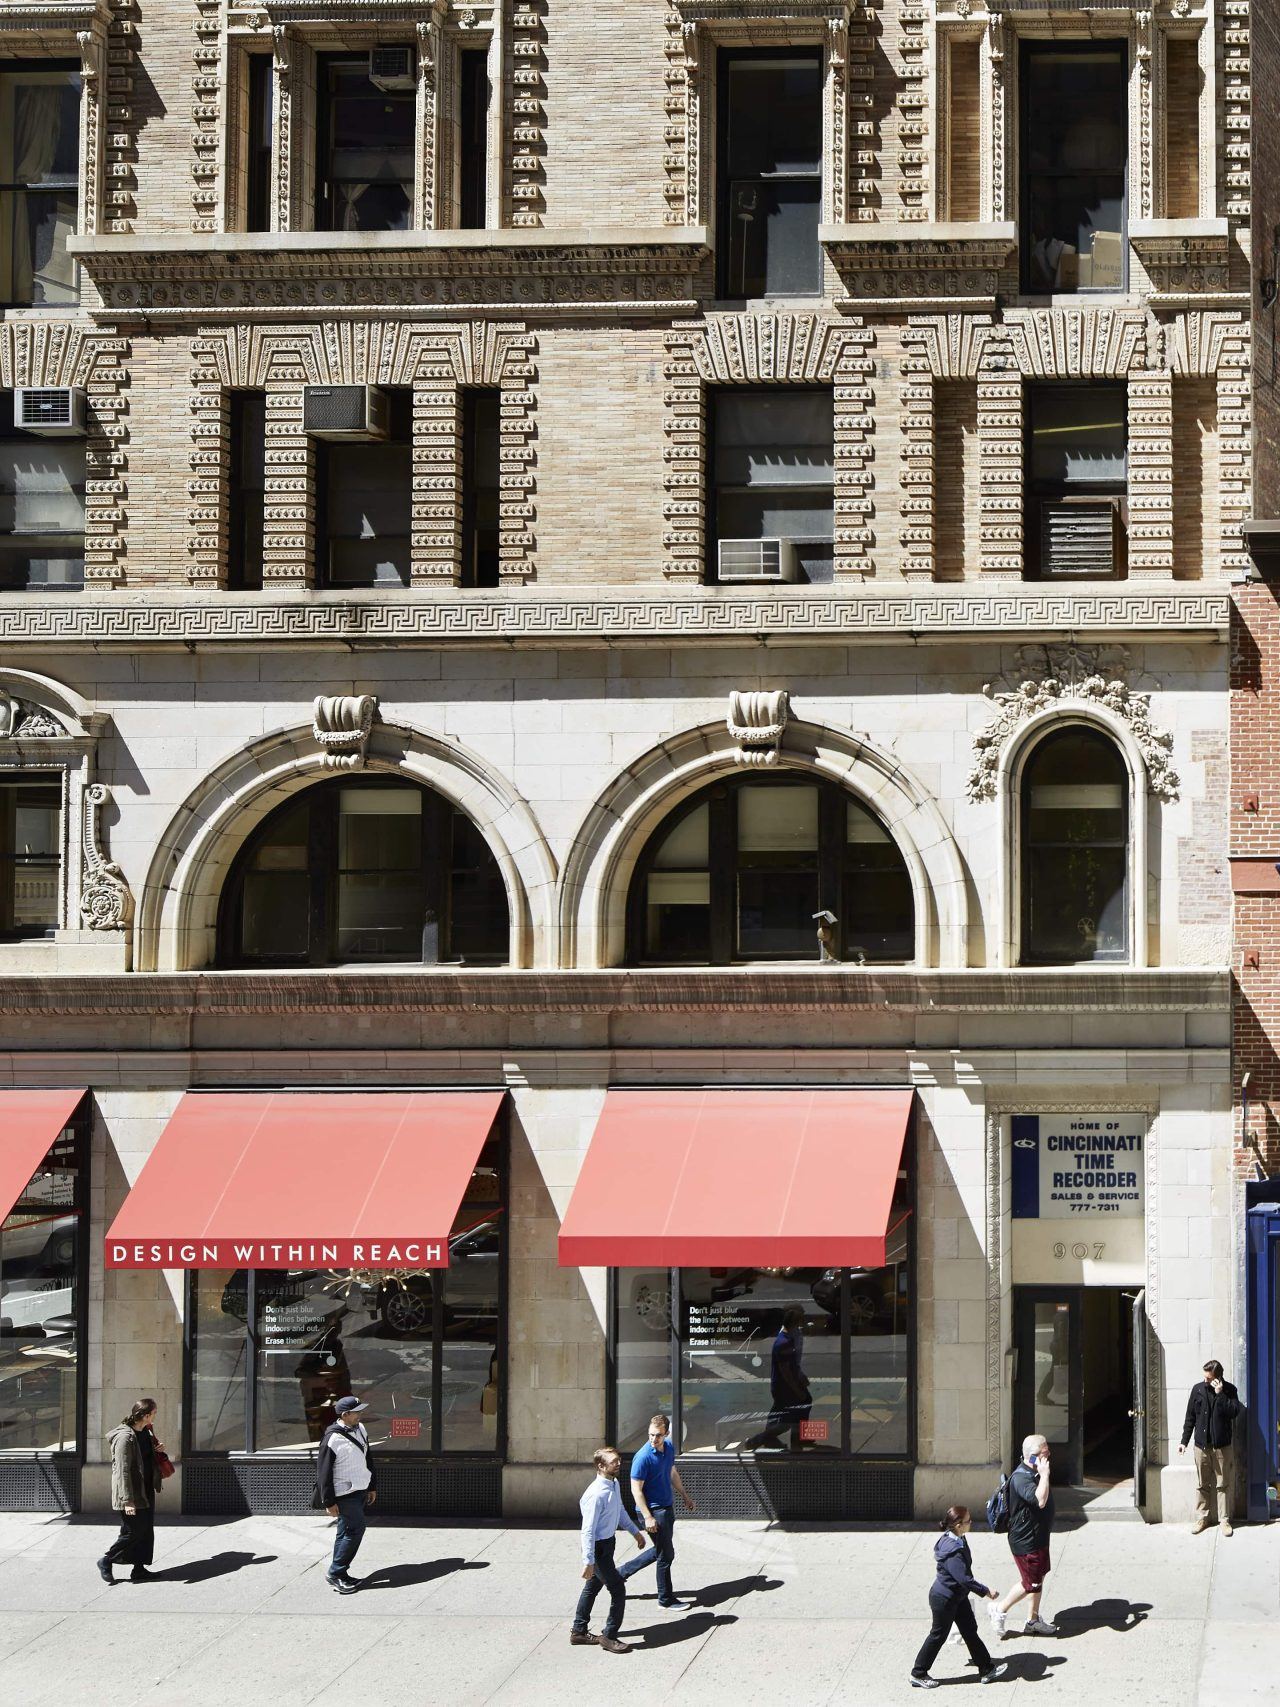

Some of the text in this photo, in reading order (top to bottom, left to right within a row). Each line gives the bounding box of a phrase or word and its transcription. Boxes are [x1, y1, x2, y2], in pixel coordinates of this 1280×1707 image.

[1070, 1122, 1120, 1130] HOME OF
[1047, 1135, 1142, 1152] CINCINNATI
[1074, 1154, 1115, 1170] TIME
[1053, 1172, 1138, 1188] RECORDER
[1050, 1192, 1140, 1200] SALES & SERVICE
[1070, 1203, 1120, 1212] 777-7311
[113, 1244, 442, 1262] DESIGN WITHIN REACH
[1053, 1242, 1106, 1260] 907
[265, 1306, 284, 1314] Don't
[285, 1306, 299, 1315] just
[689, 1306, 738, 1315] Don't just blur
[265, 1315, 277, 1323] the
[689, 1316, 701, 1324] the
[689, 1338, 709, 1346] Erase
